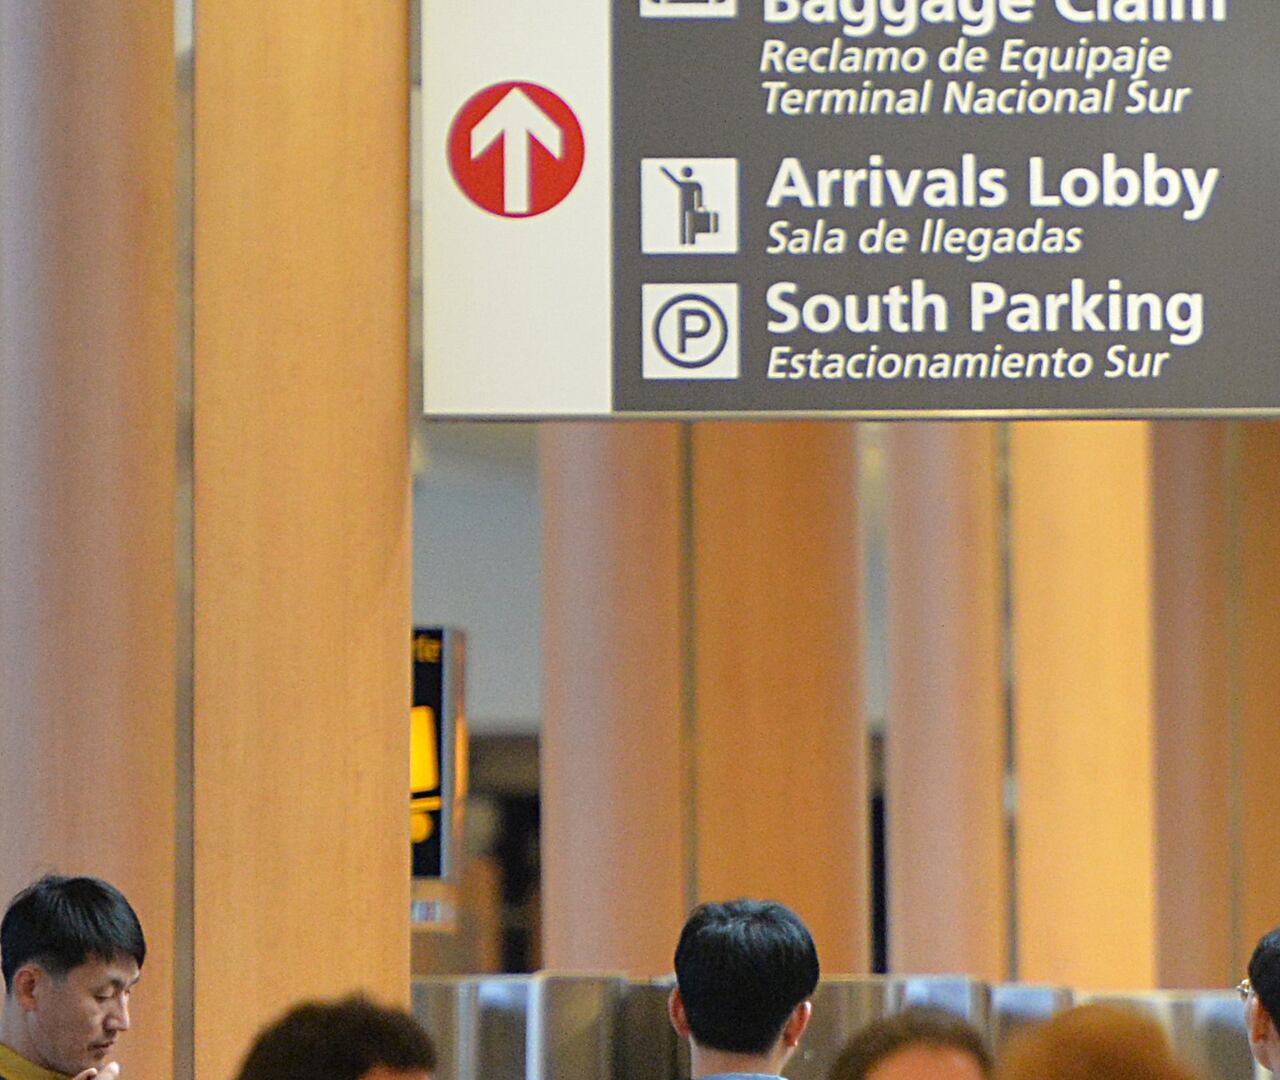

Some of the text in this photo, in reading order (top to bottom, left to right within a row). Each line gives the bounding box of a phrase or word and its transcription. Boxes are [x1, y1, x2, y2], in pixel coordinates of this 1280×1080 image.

[760, 37, 1172, 80] Reclamo de Equipaje
[761, 78, 1192, 115] Terminal Nacional Sur
[766, 152, 1219, 221] Arrivals Lobby
[766, 217, 1083, 261] Sala de llegadas
[766, 278, 1203, 346] South Parking
[767, 344, 1171, 379] Estacionamiento Sur
